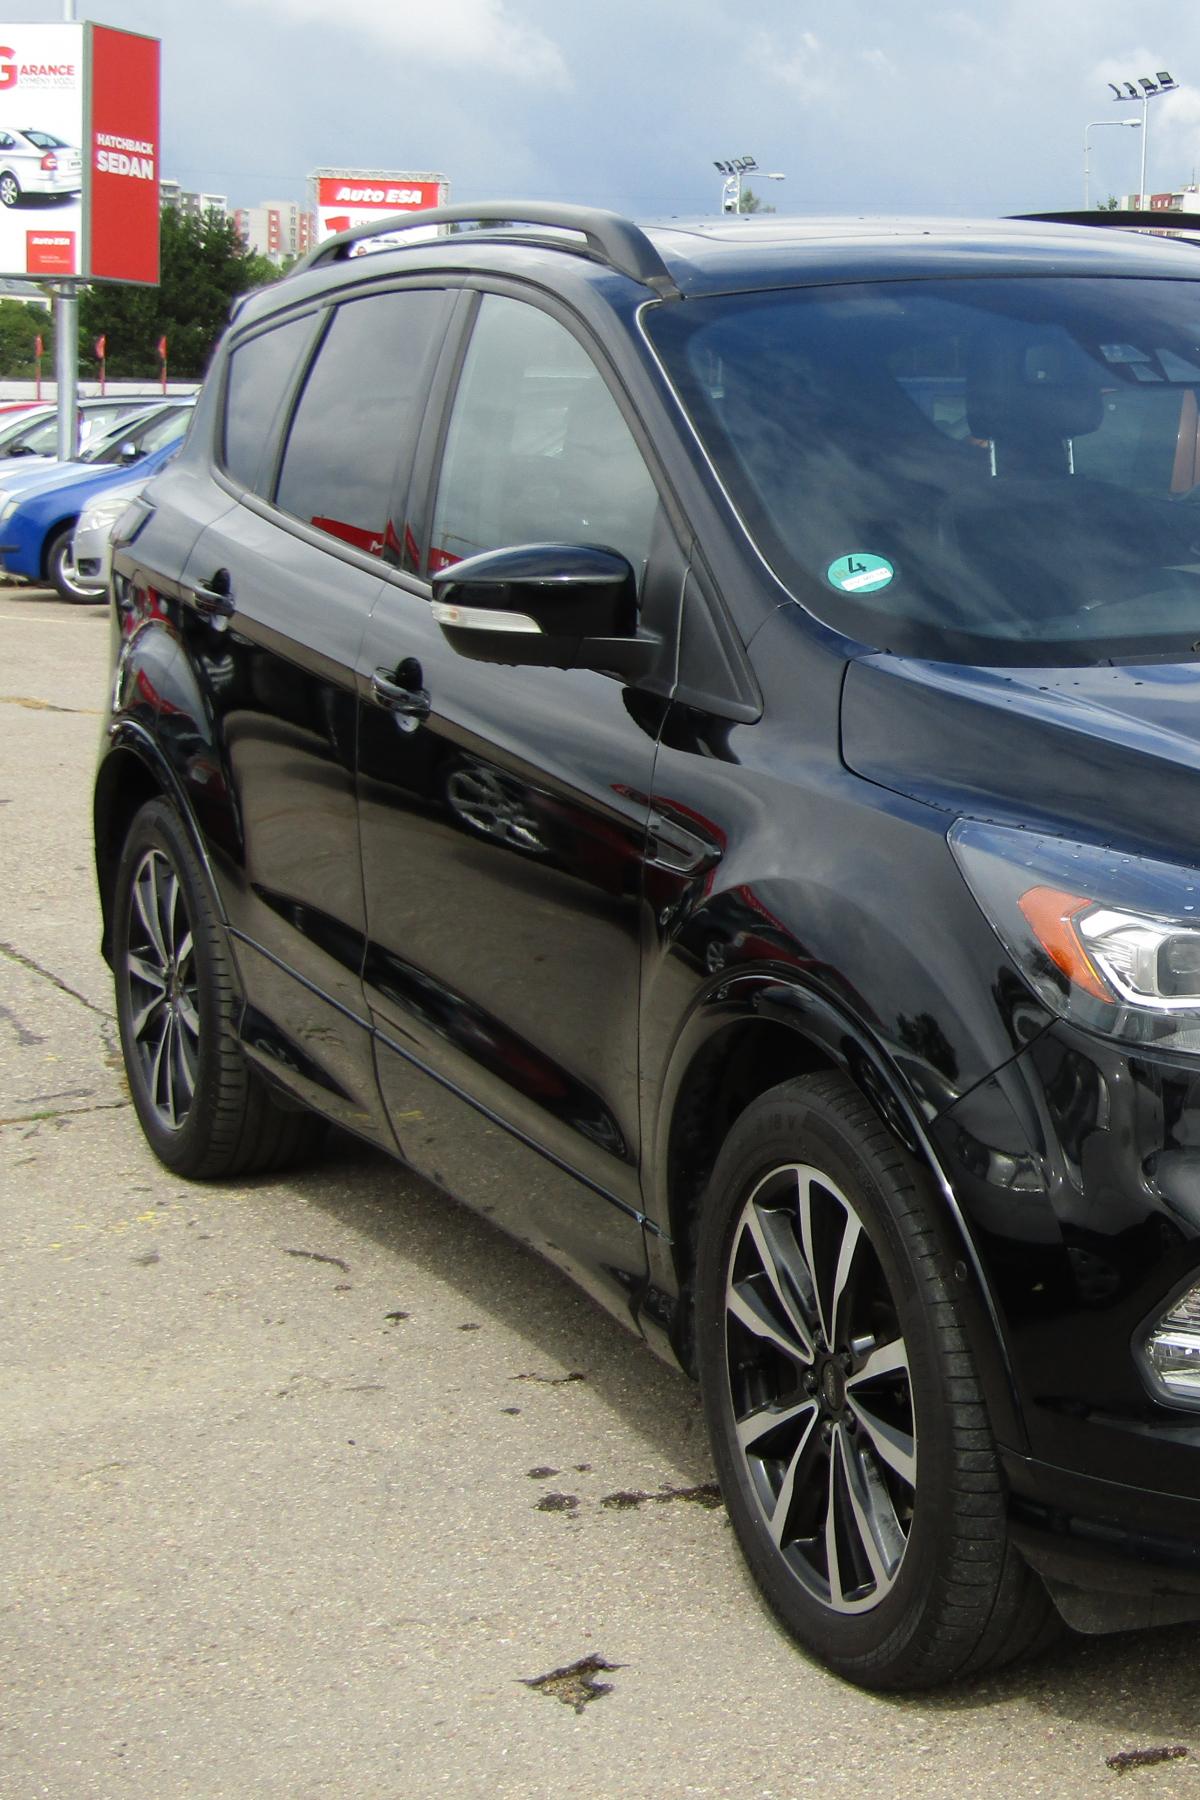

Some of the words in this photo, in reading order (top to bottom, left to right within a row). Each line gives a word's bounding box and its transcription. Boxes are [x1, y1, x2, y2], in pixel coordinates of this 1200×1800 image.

[97, 132, 154, 155] HATCHBACK
[97, 151, 154, 180] SEDAN
[336, 187, 384, 202] Auto
[386, 189, 422, 204] ESA
[847, 557, 867, 573] 4
